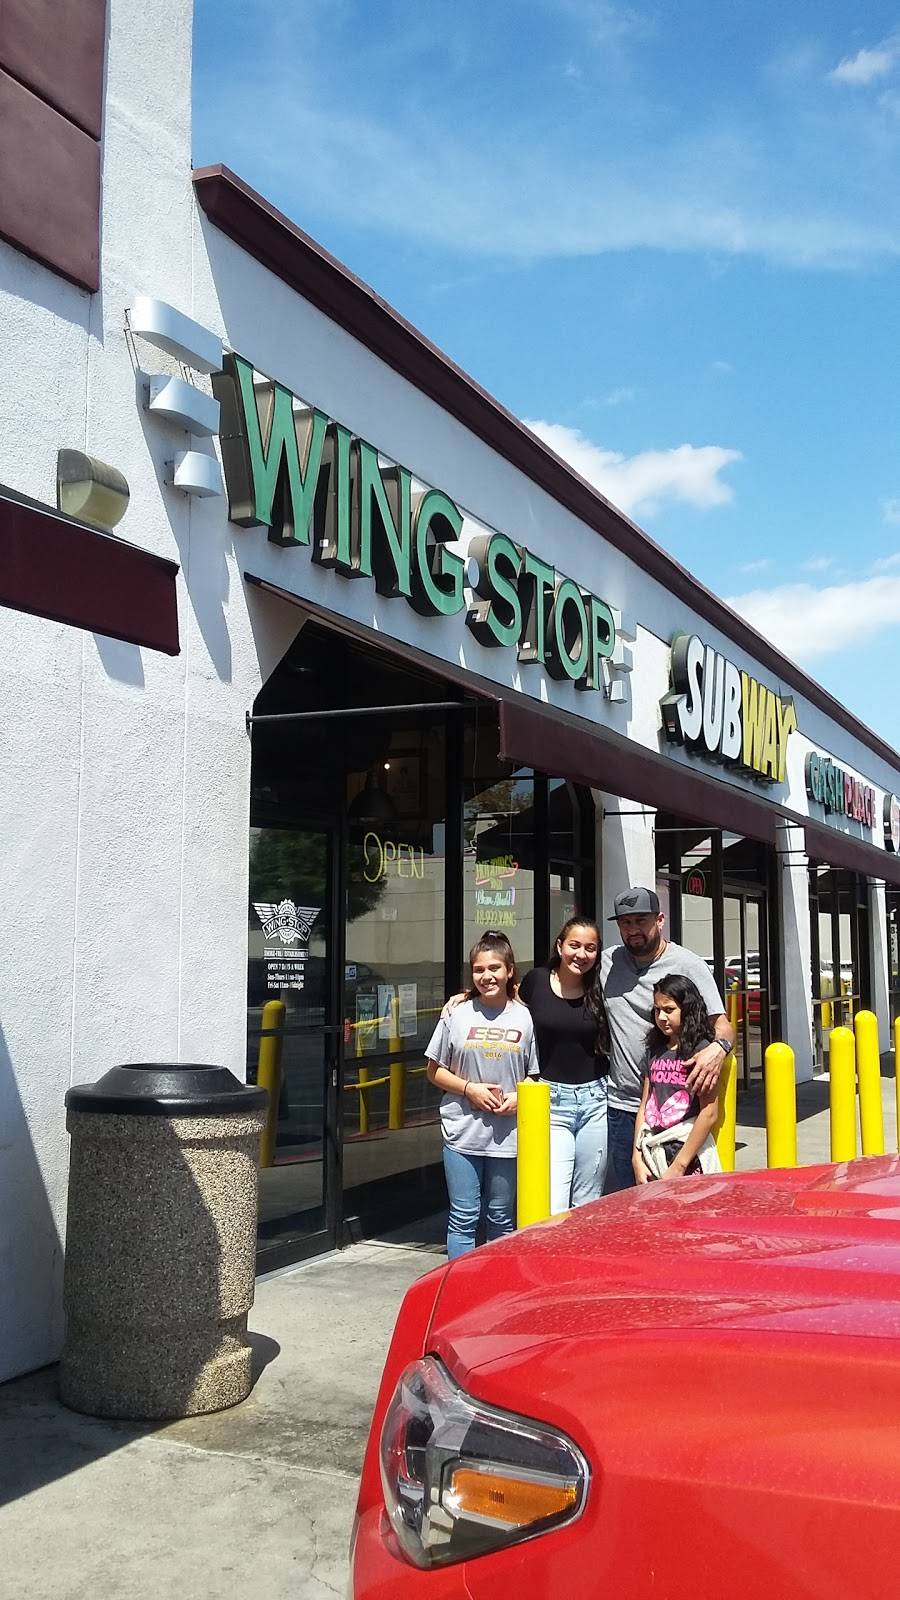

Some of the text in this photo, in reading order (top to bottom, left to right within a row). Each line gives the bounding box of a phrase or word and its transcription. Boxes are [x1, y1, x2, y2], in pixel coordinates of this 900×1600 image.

[226, 354, 616, 691] WING STOP
[674, 634, 797, 783] SUBWAY
[808, 751, 844, 815] CASH
[844, 771, 877, 829] PLACE
[363, 831, 424, 882] OPEN
[689, 876, 704, 896] OPEN
[266, 916, 308, 933] WING STOP
